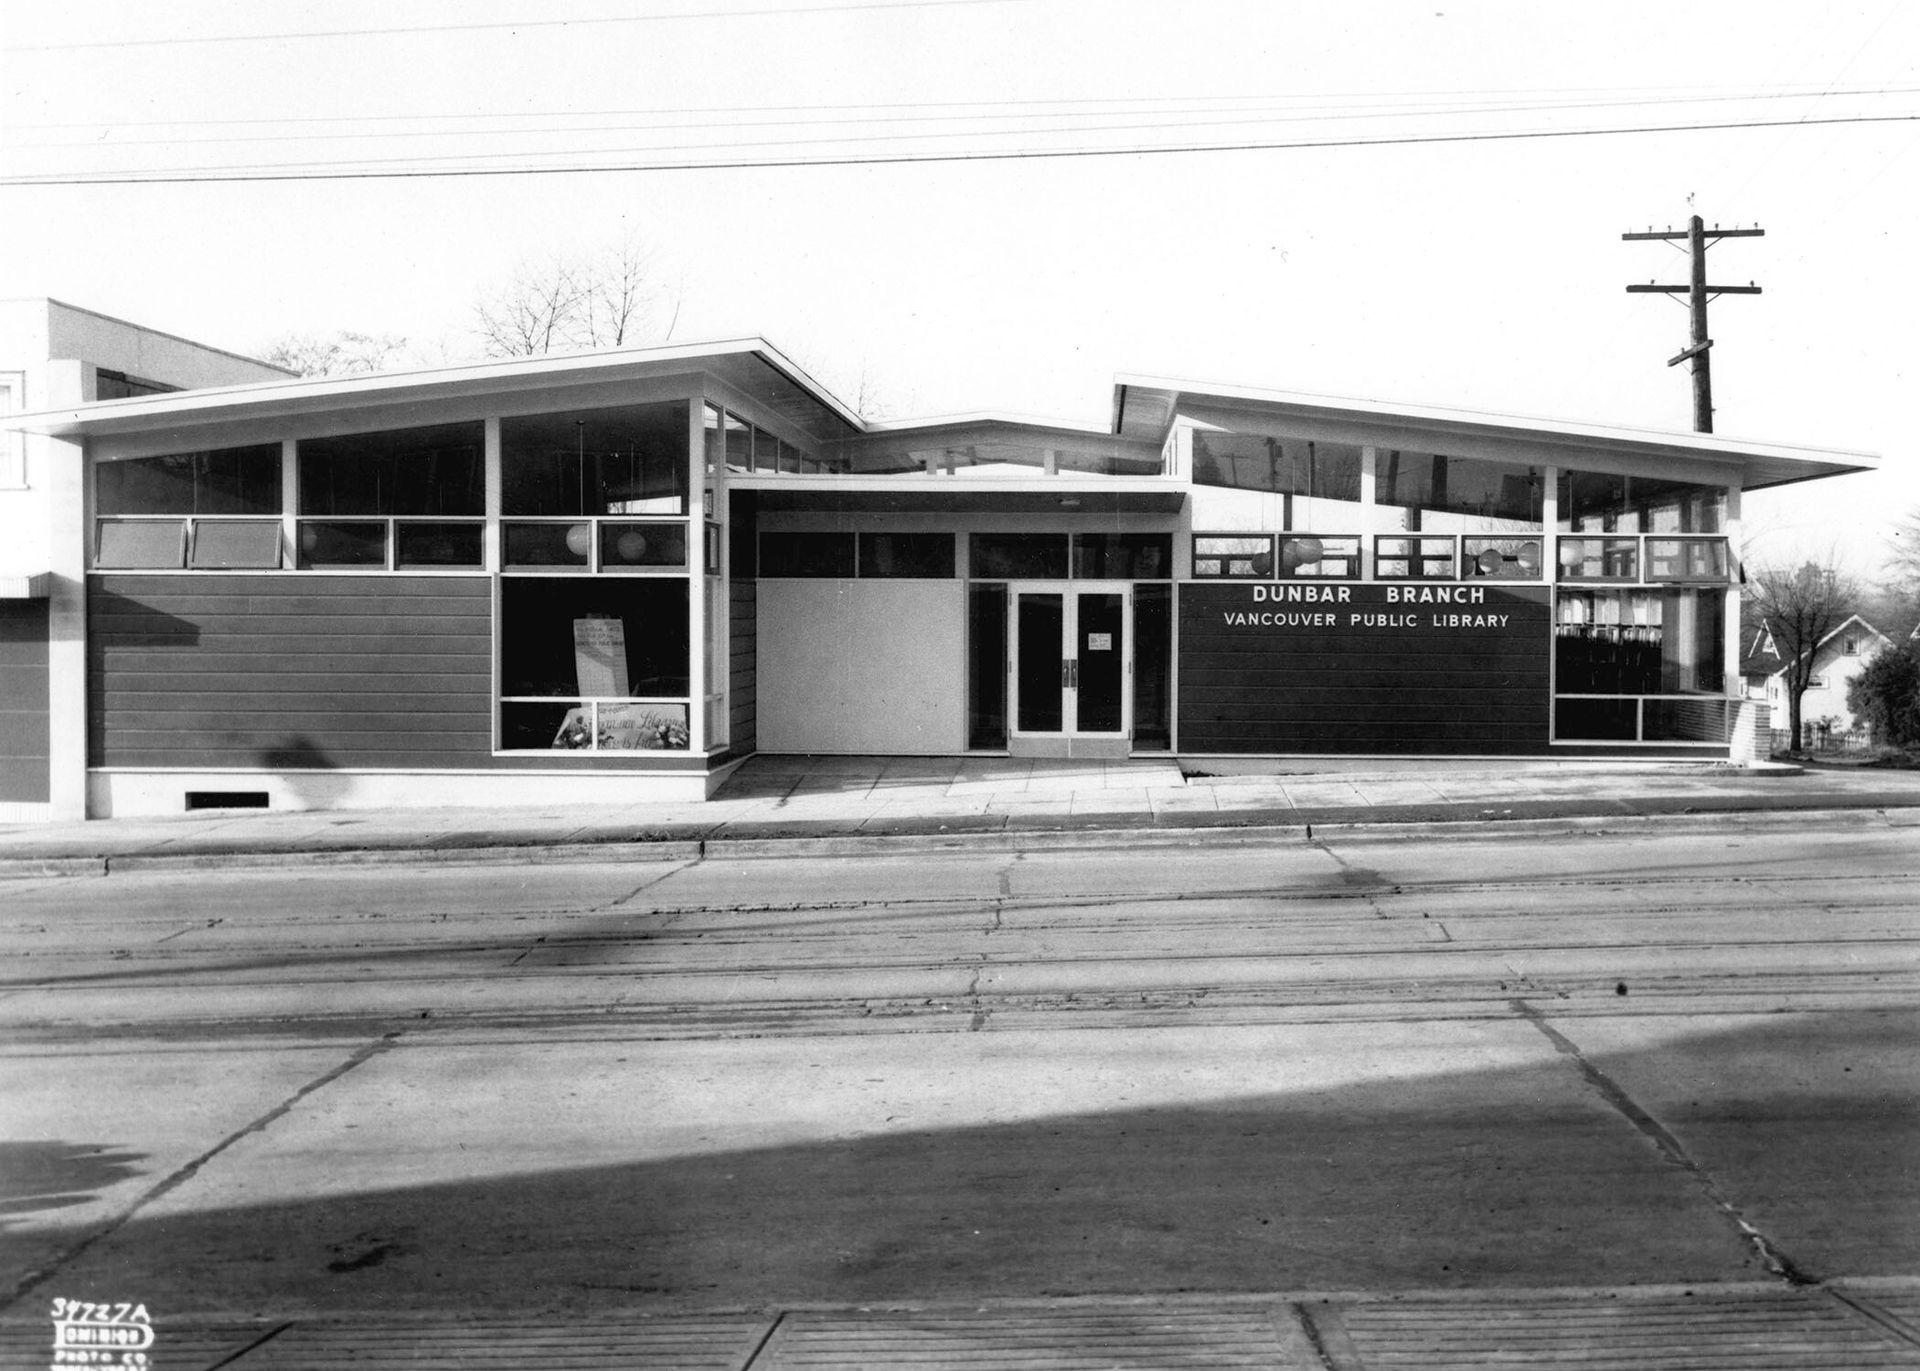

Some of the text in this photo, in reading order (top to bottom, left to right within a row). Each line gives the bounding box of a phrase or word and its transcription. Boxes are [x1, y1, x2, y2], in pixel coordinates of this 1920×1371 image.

[1253, 585, 1485, 604] DUNBAR BRANCH
[1224, 612, 1509, 628] VANCOUVER PUBLIC LIBRARY
